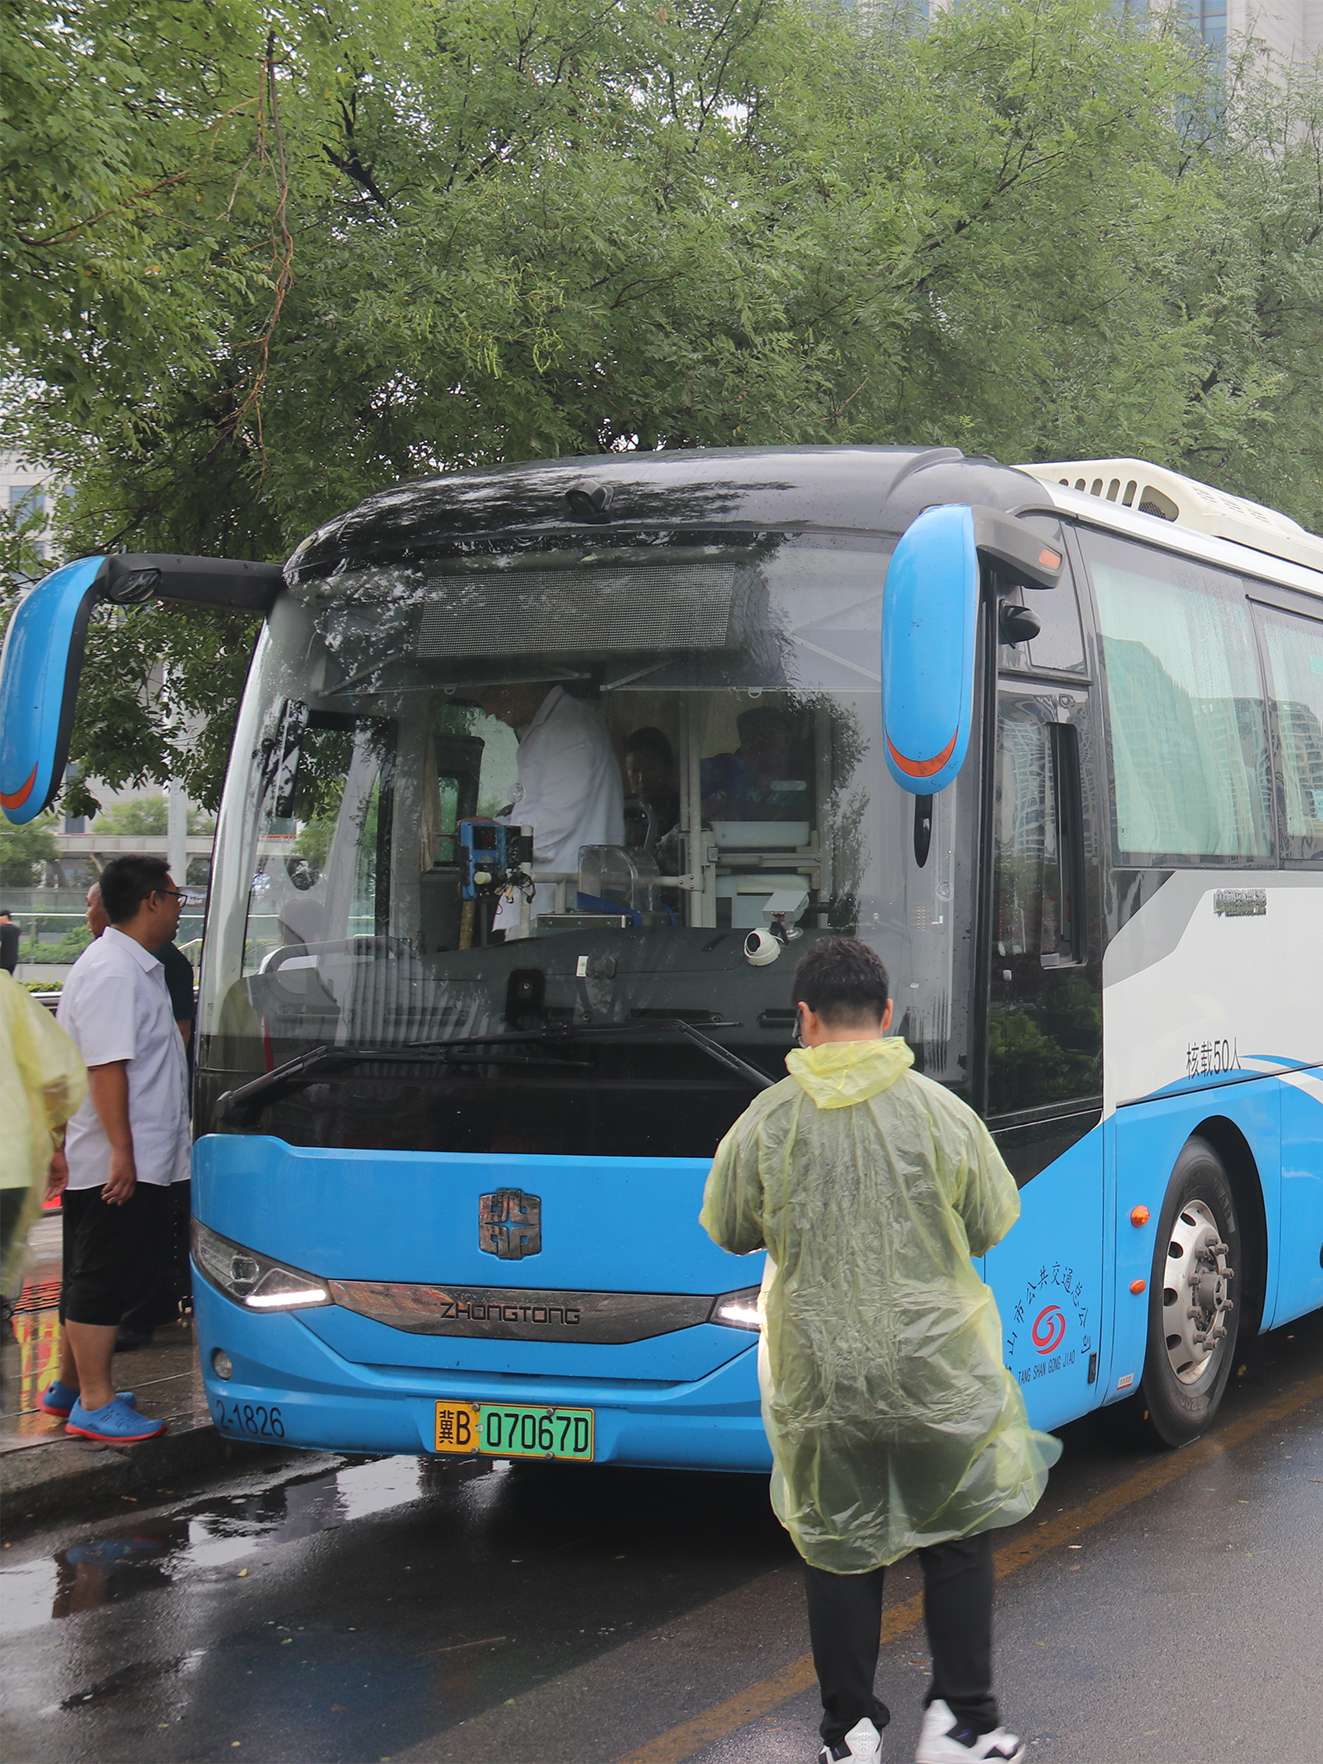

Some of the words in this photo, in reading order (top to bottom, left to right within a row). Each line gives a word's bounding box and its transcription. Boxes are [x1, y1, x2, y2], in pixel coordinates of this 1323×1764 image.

[1186, 1036, 1241, 1080] 核载50人
[440, 1302, 581, 1325] ZHONGTONG
[1018, 1366, 1031, 1385] TANG
[1033, 1361, 1046, 1380] SHAN
[1048, 1355, 1061, 1374] GONG
[1063, 1349, 1076, 1368] JIAO
[216, 1399, 285, 1438] 2-1826
[486, 1412, 589, 1453] 07067D
